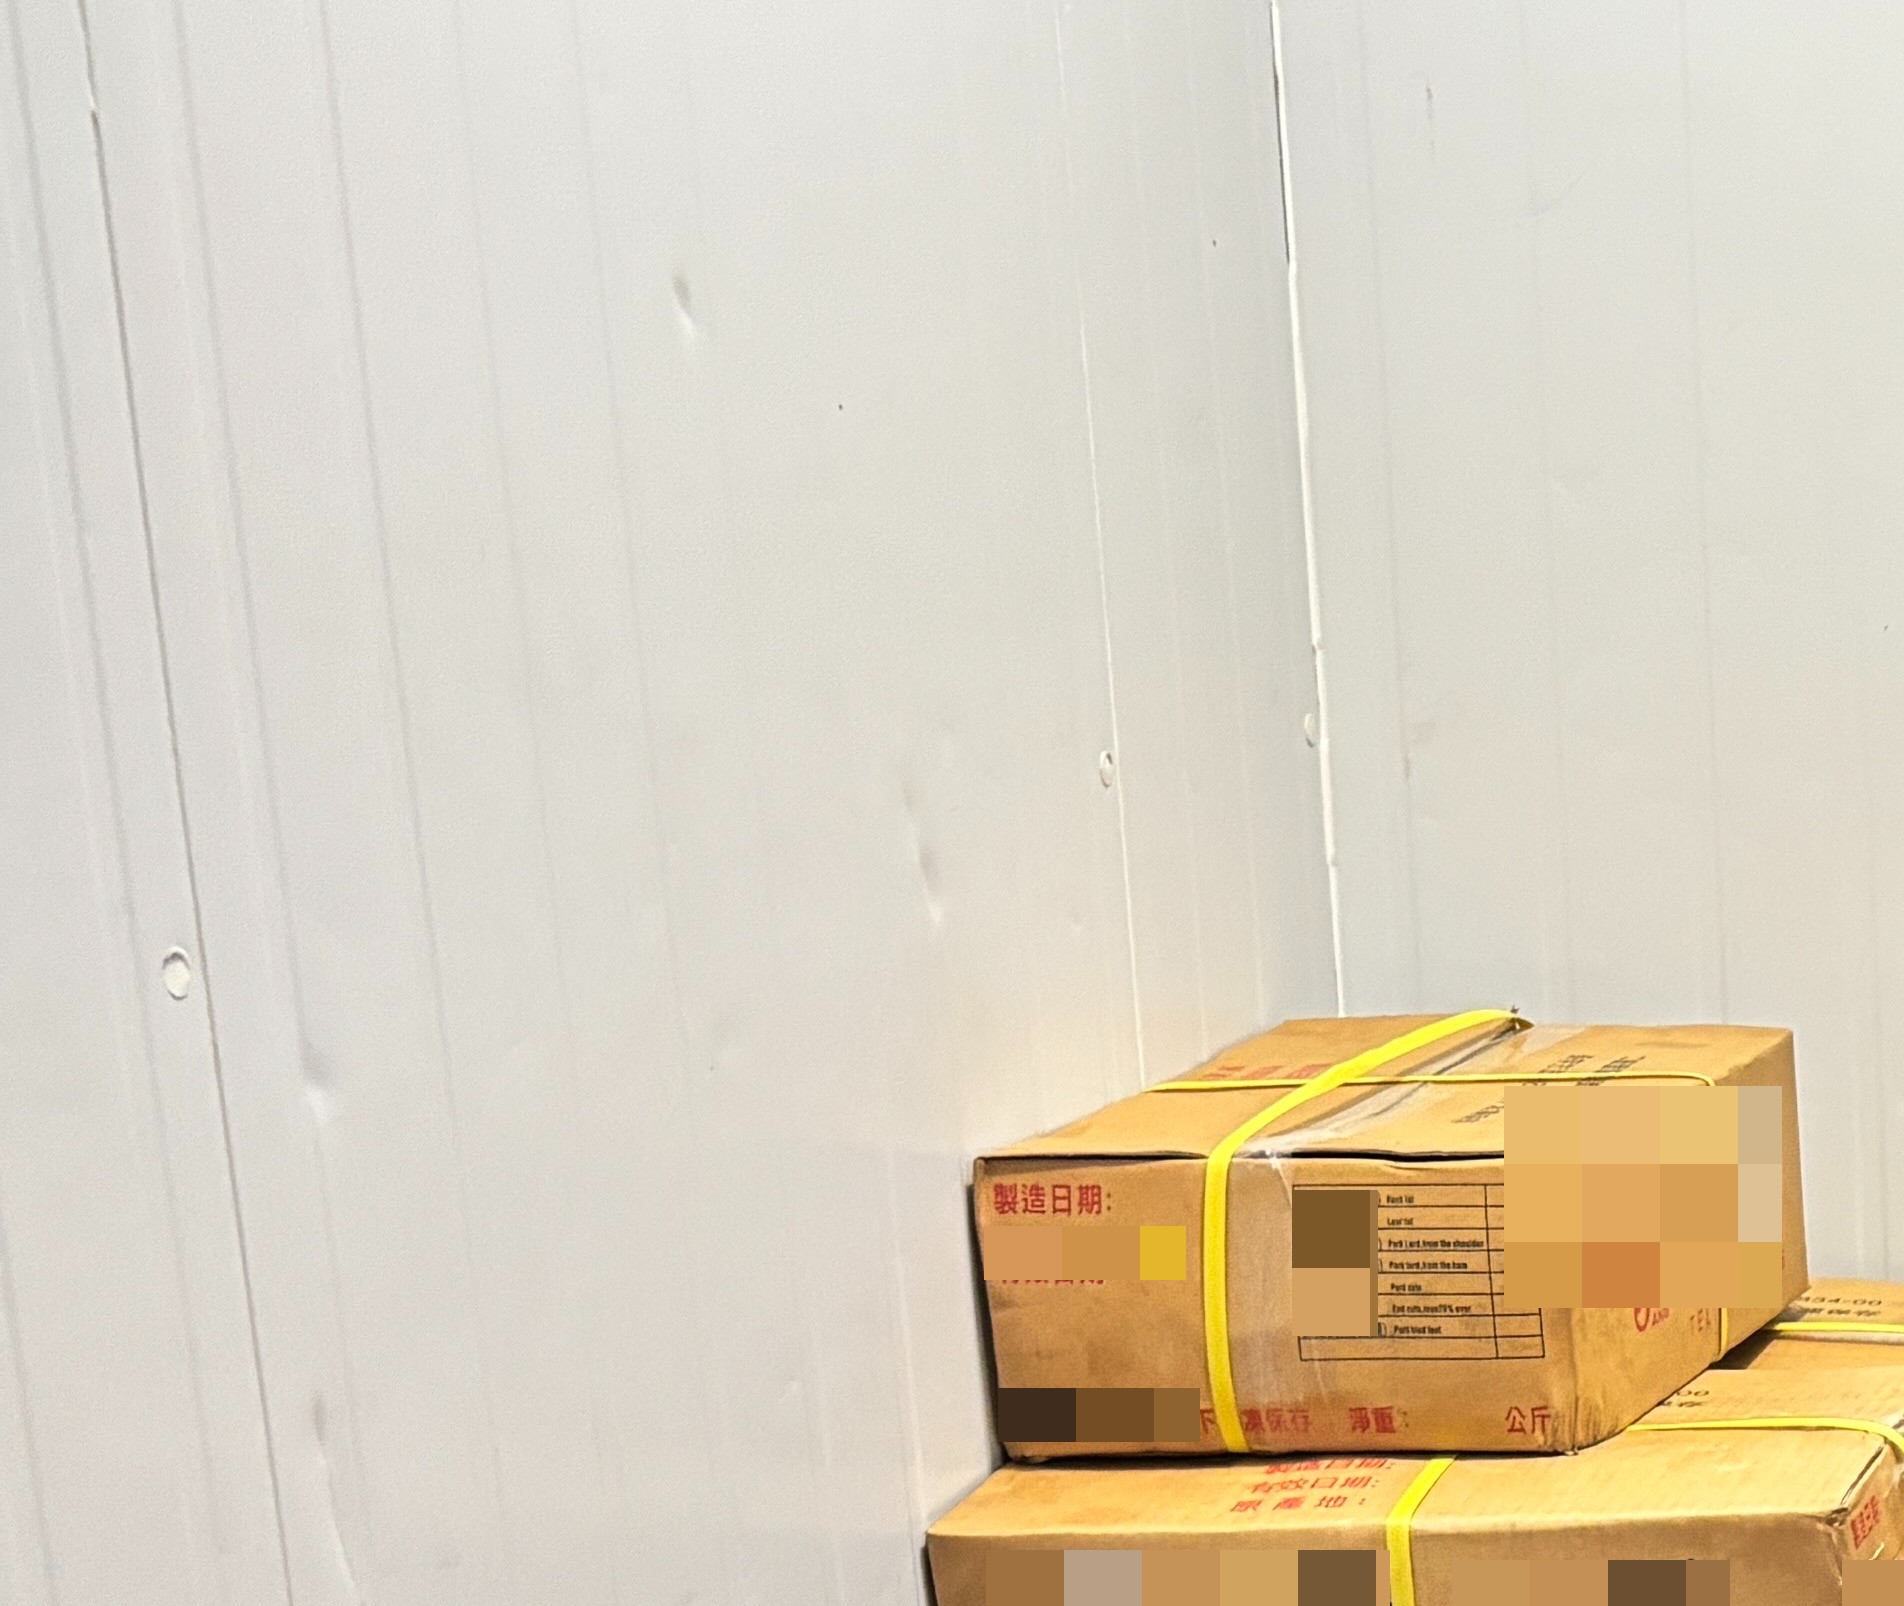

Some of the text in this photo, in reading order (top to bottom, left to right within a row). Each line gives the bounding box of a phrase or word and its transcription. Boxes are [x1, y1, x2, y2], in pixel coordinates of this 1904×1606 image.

[993, 1183, 1112, 1216] 製造日期:
[1504, 1405, 1551, 1434] 公斤
